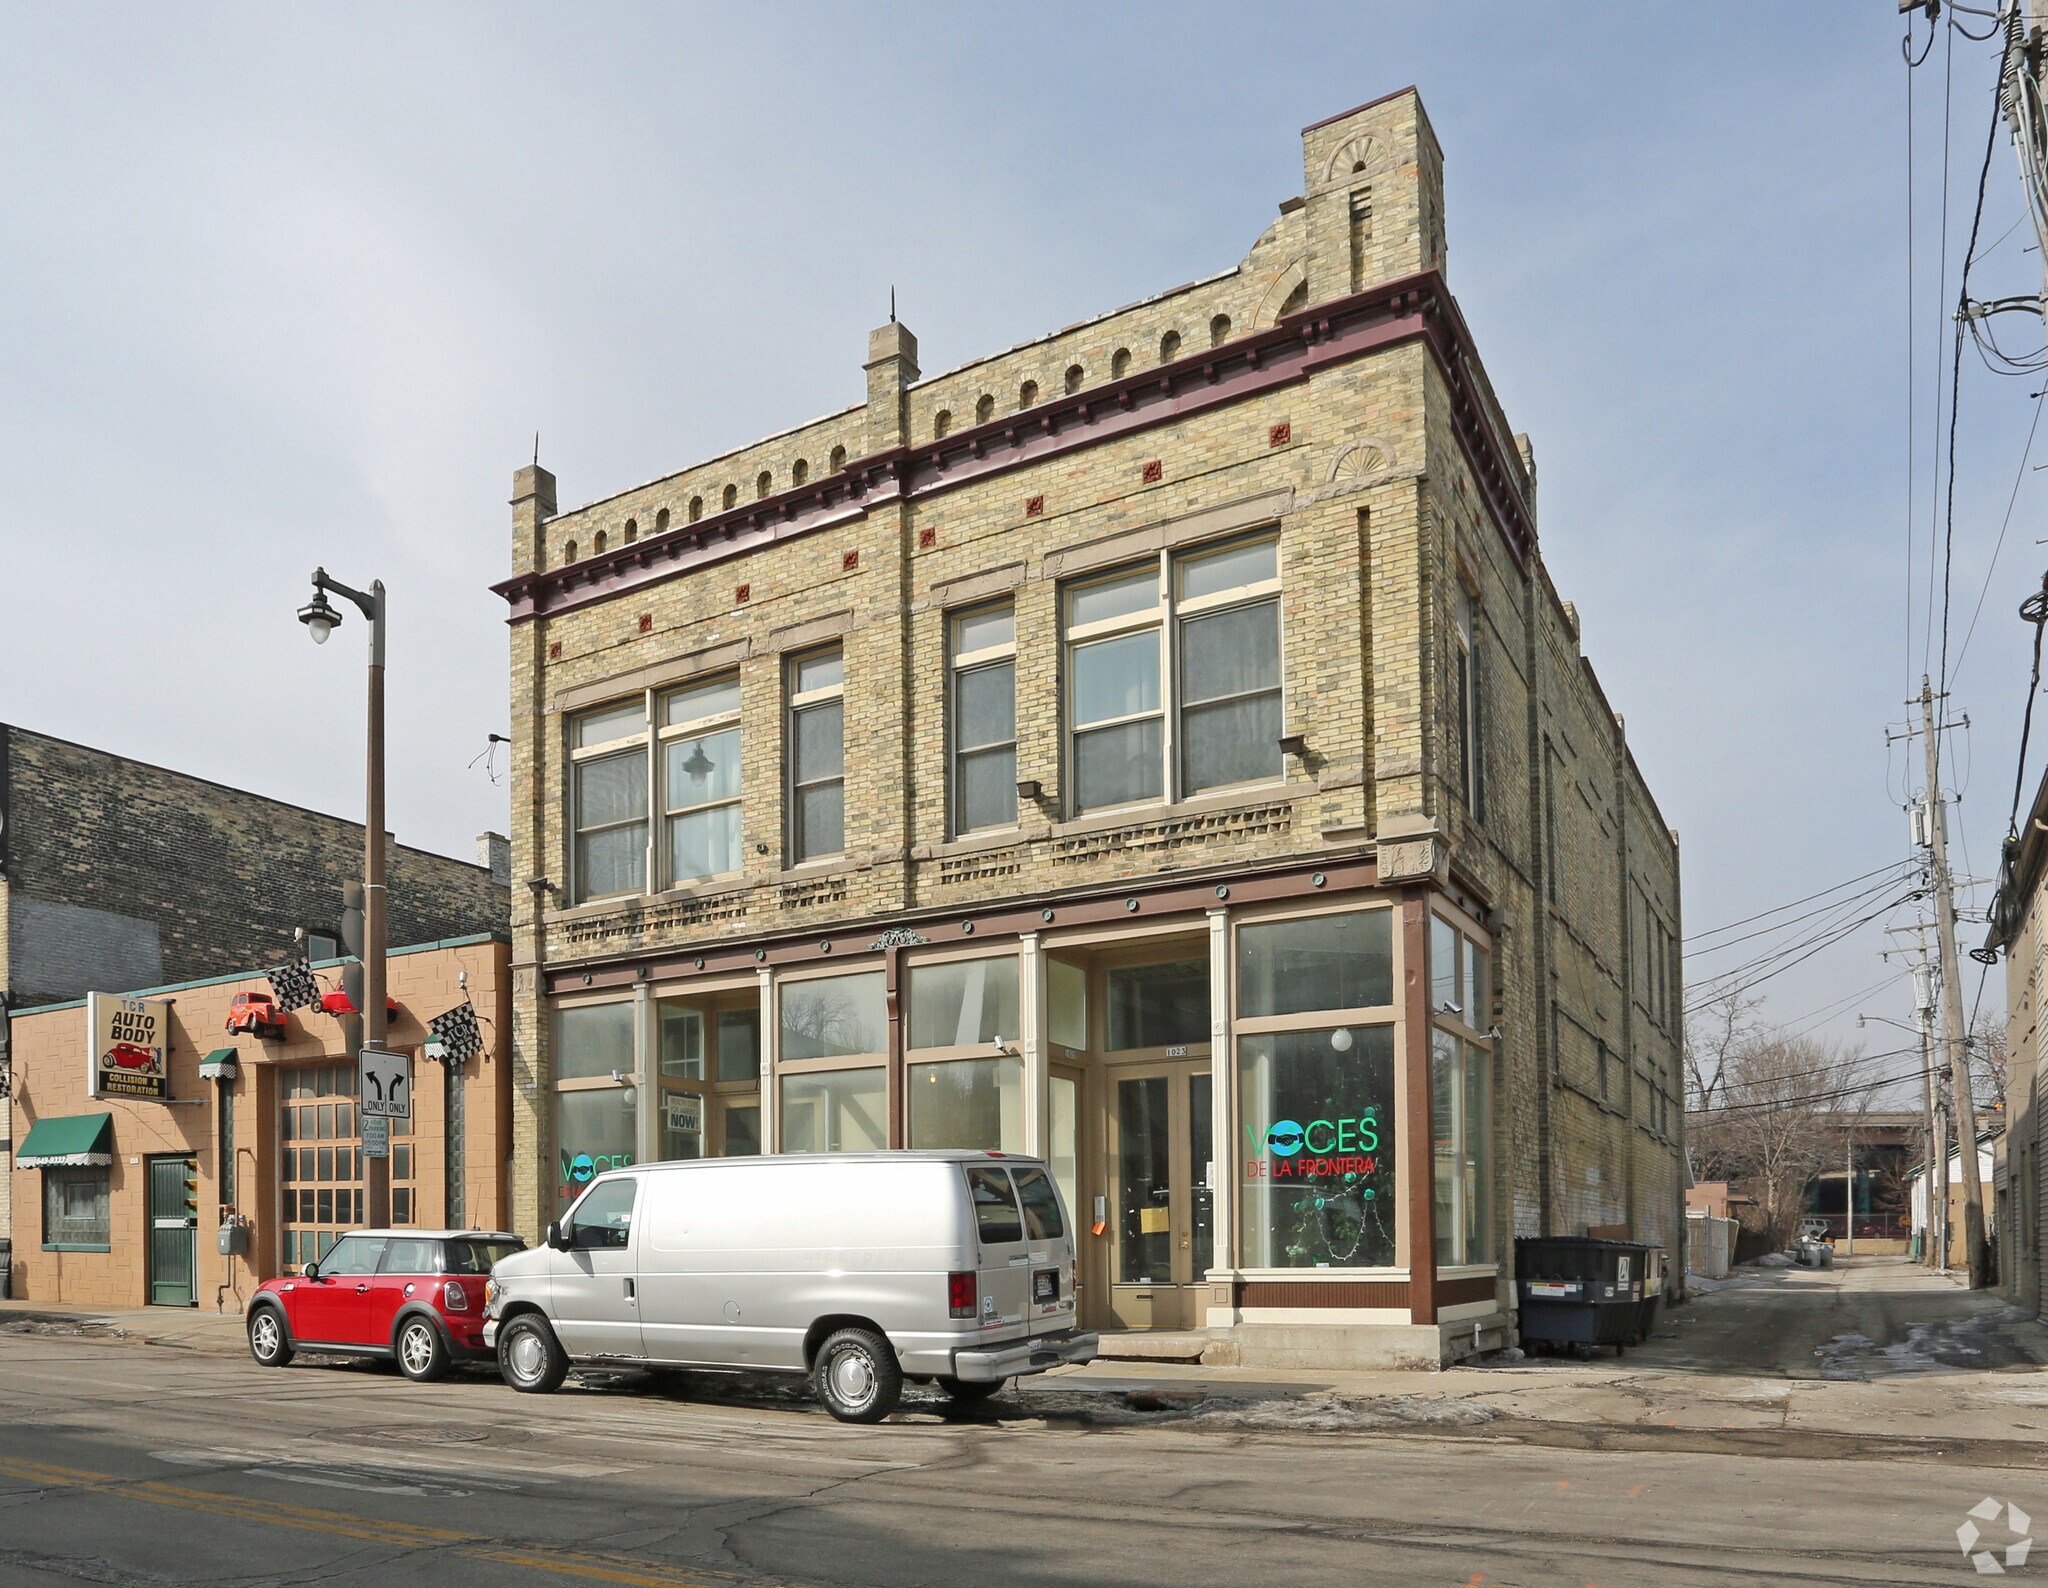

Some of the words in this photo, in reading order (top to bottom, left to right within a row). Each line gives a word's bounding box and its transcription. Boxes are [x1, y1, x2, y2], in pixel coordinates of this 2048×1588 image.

[282, 975, 307, 992] TCR
[121, 1000, 145, 1013] TCR
[111, 1012, 156, 1030] AUTO
[111, 1026, 156, 1044] BODY
[447, 1023, 471, 1042] TCR
[109, 1073, 148, 1085] COLLISION
[152, 1078, 159, 1087] &
[106, 1082, 159, 1096] RESTORATION
[367, 1100, 385, 1112] ONLY
[389, 1102, 406, 1114] ONLY
[363, 1119, 369, 1132] 2
[670, 1113, 699, 1130] NOW!
[1246, 1117, 1379, 1157] VOCES
[1247, 1161, 1267, 1178] DE
[1273, 1160, 1292, 1177] LA
[1298, 1156, 1376, 1177] FRONTERA
